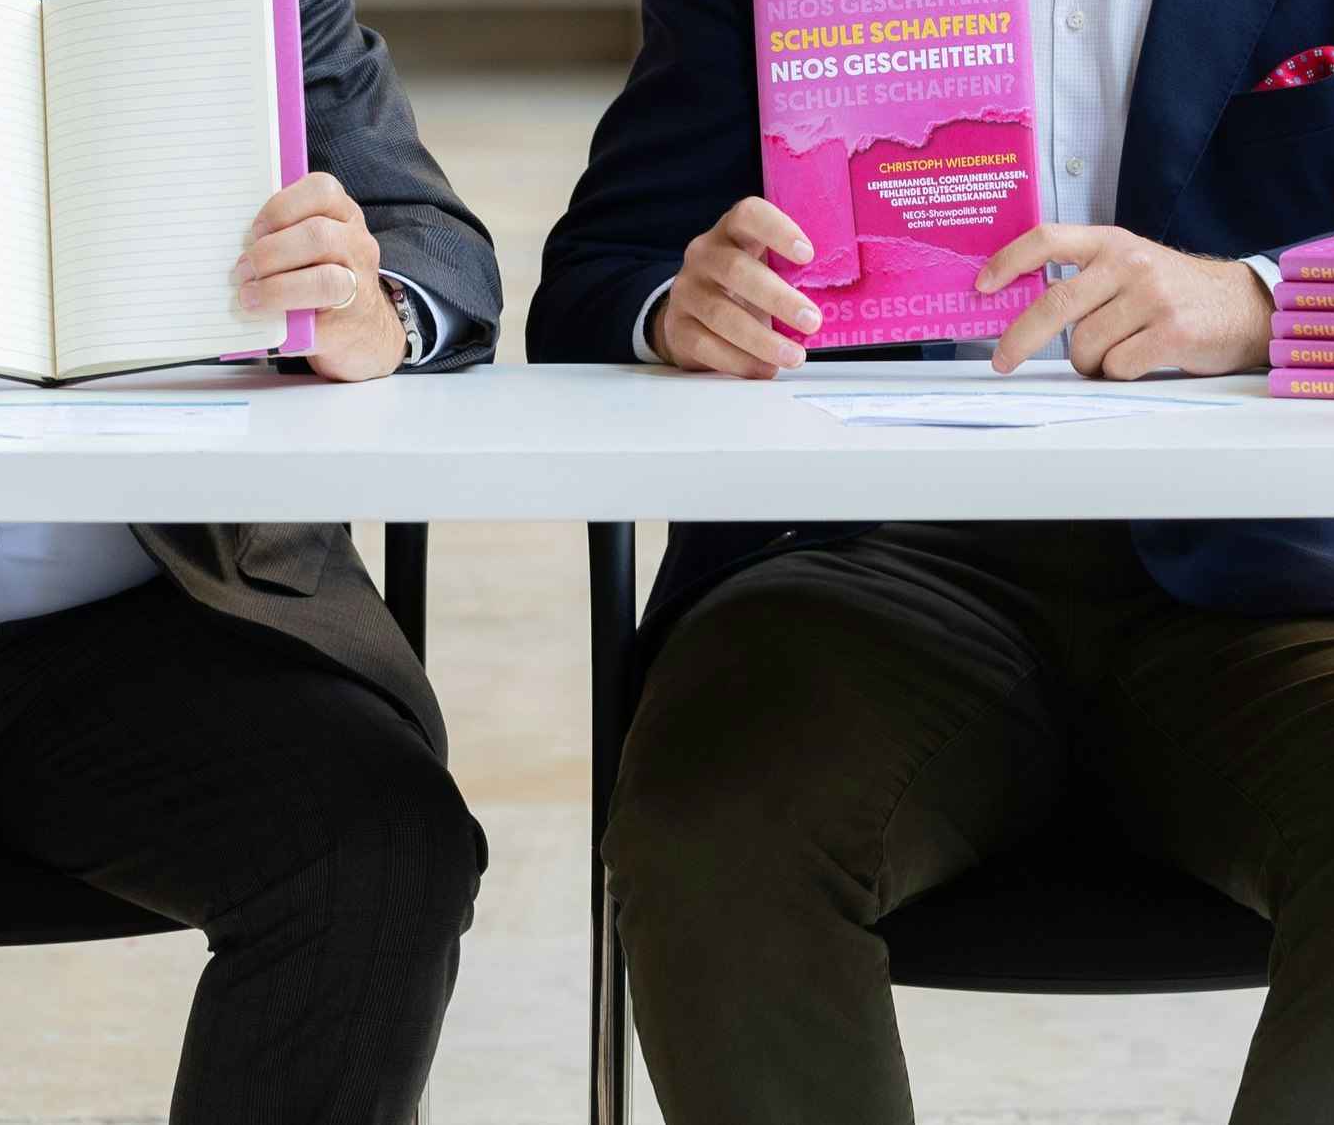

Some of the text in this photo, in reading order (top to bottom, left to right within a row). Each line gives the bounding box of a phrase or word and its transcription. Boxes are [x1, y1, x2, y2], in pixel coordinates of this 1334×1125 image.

[770, 12, 1011, 53] SCHULE SCHAFFEN?
[771, 43, 1015, 83] NEOS GESCHEITERT!
[773, 74, 1015, 113] SCHULE SCHAFFEN?
[879, 153, 1017, 174] CHRISTOPH WIEDERKEHR
[867, 170, 1029, 191] LEHRERMANGEL, CONTAINERKLASSEN,
[879, 180, 1017, 199] FEHLENDE DEUTSCHFÖRDERUNG,
[891, 190, 1008, 207] GEWALT, FÖRDERSKANDALE
[903, 205, 997, 220] NEOS-Showpolitik statt
[908, 215, 993, 229] echter Verbesserung
[822, 287, 1031, 323] OS GESCHEITERT!
[790, 329, 883, 349] CHULE
